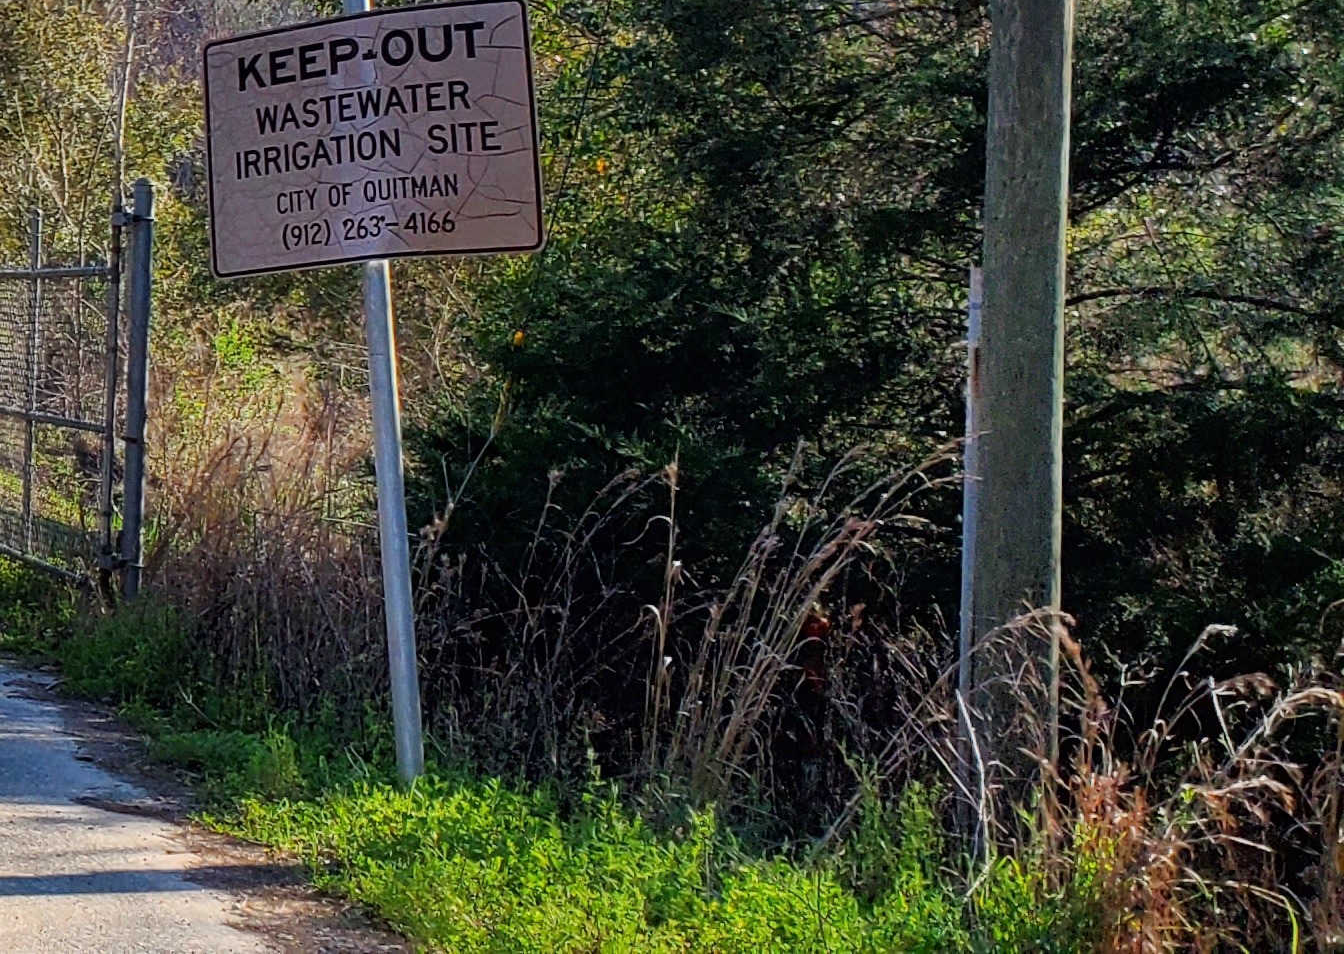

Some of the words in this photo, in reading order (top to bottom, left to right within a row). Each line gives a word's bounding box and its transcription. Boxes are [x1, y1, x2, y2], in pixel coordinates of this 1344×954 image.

[238, 21, 485, 92] KEEP-OUT
[256, 80, 471, 135] WASTEWATER
[235, 128, 401, 180] IRRIGATION
[427, 121, 503, 153] SITE
[277, 188, 318, 214] CITY
[328, 183, 353, 207] OF
[364, 174, 459, 203] QUITMAN
[282, 218, 332, 250] (912)
